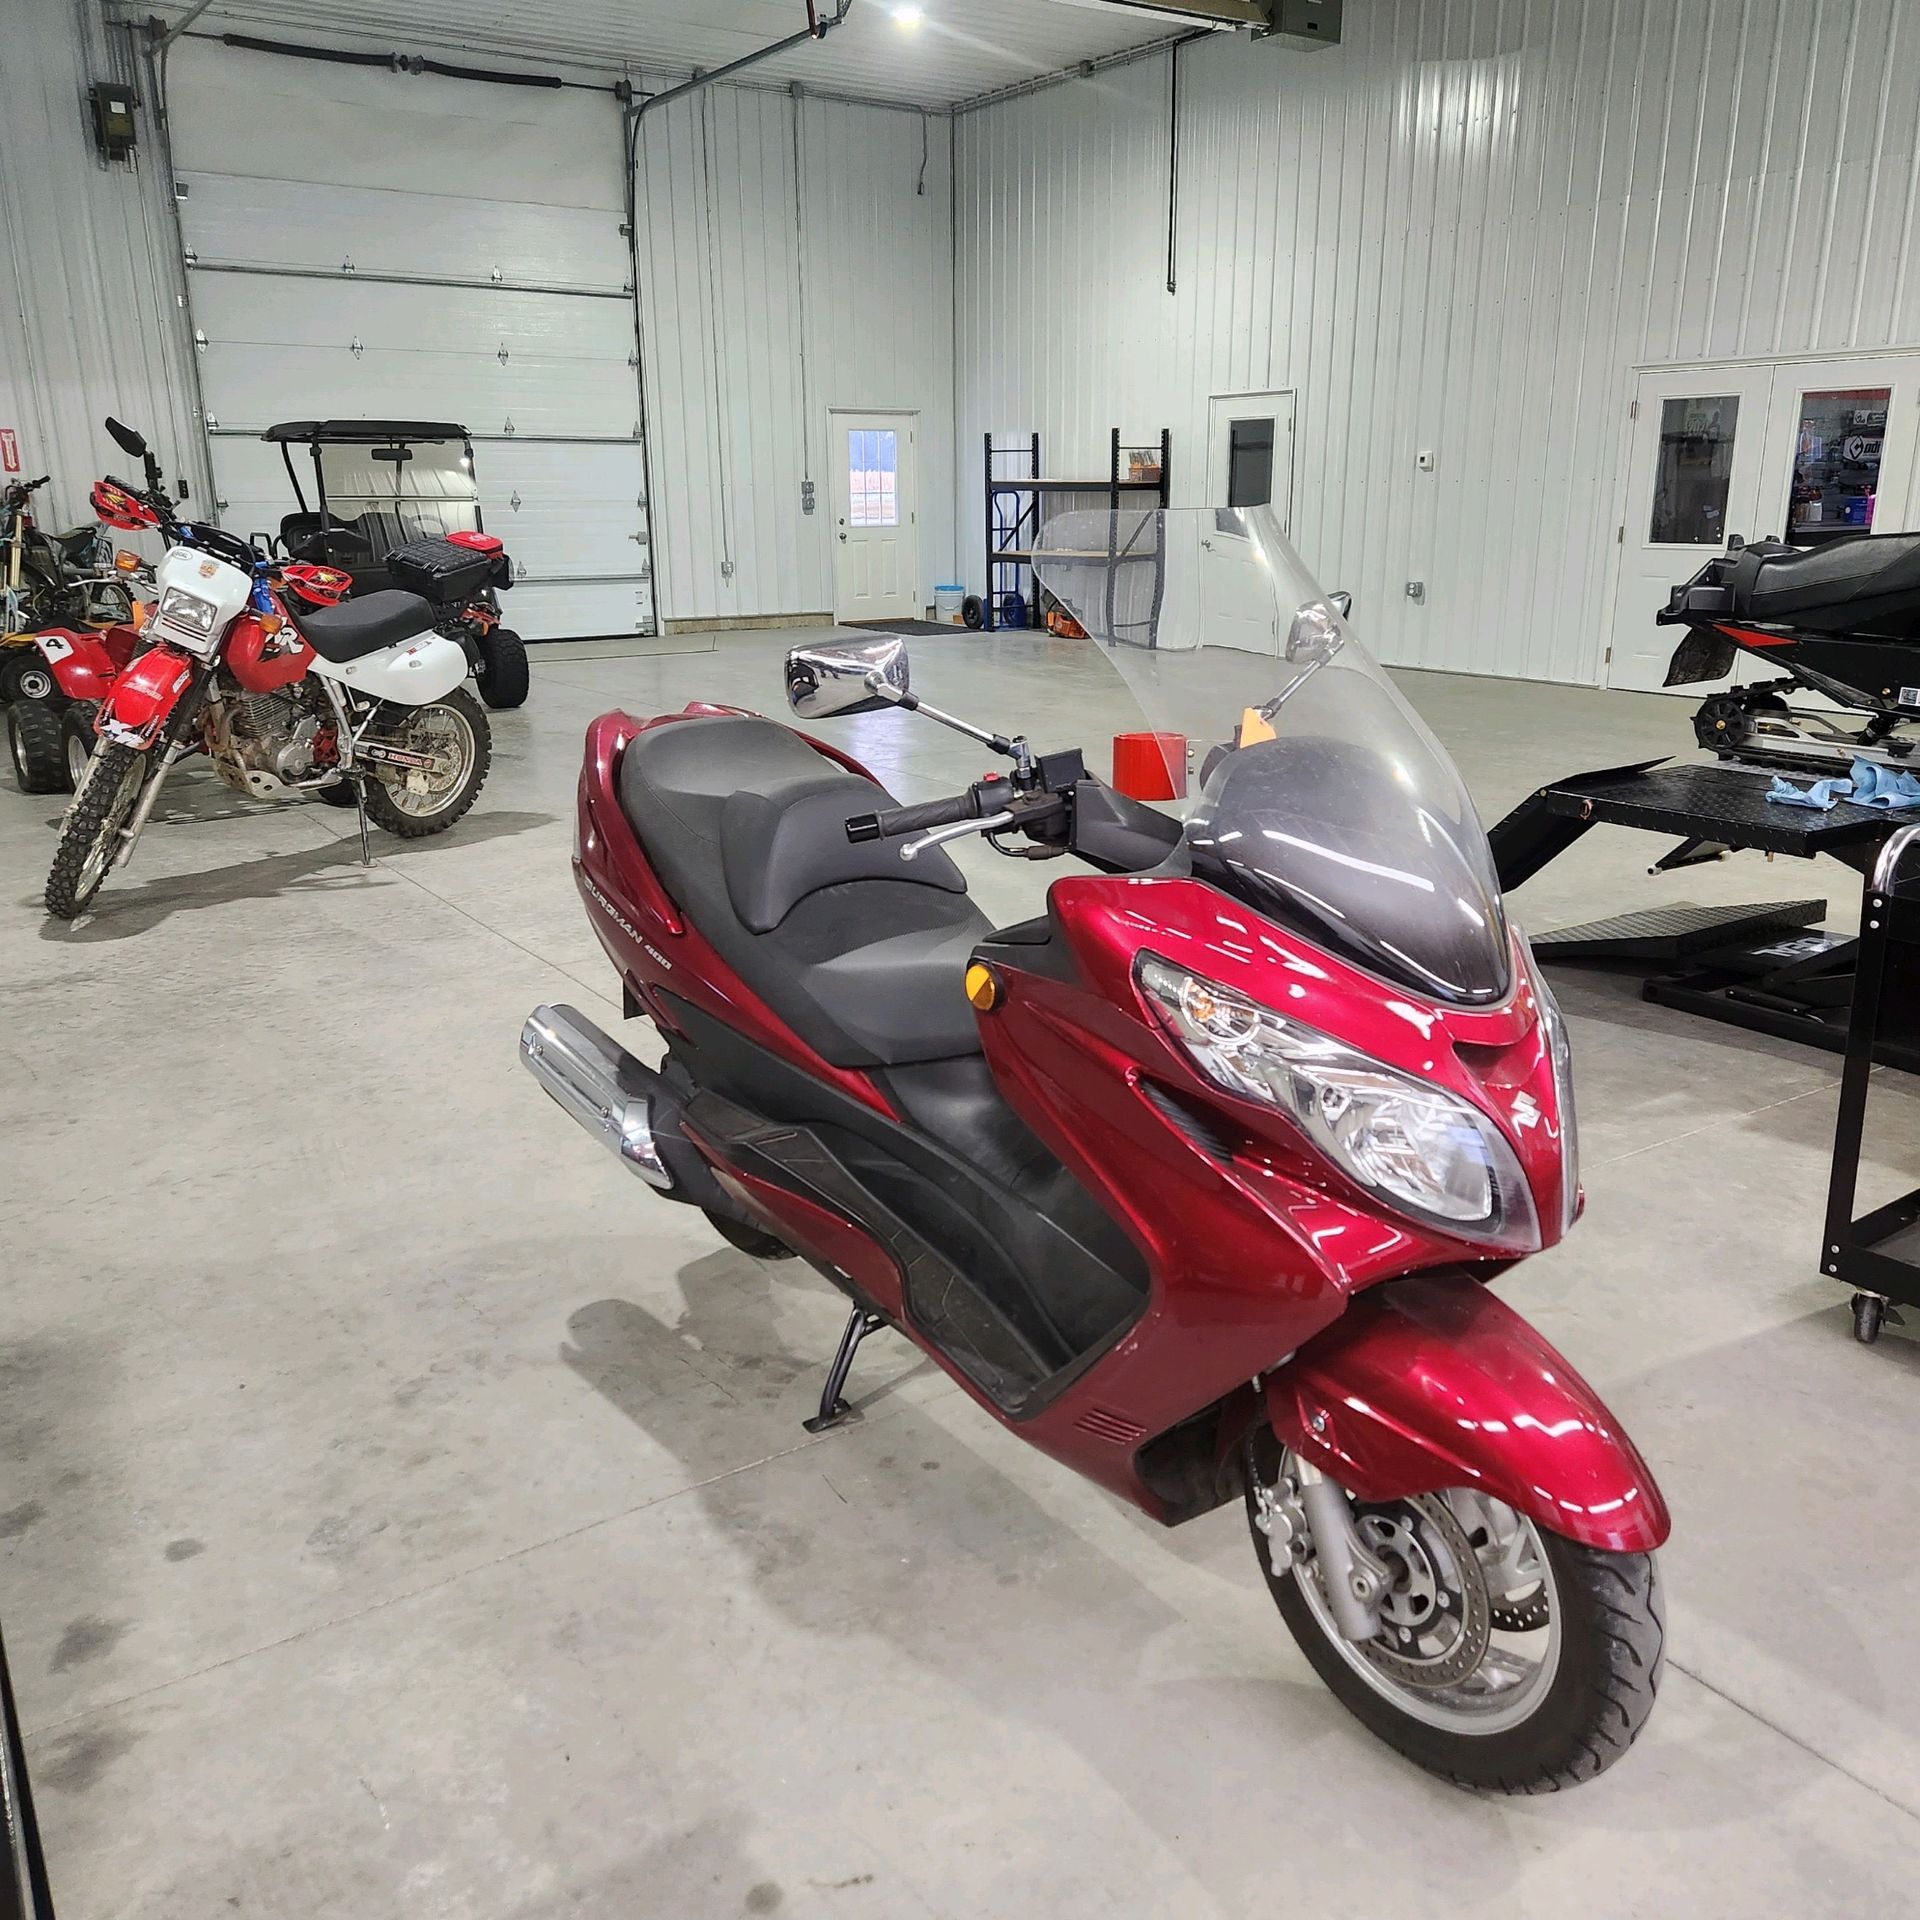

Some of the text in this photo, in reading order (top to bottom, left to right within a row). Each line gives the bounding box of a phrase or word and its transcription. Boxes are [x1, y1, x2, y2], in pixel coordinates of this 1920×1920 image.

[45, 638, 64, 649] 4
[387, 751, 423, 766] HONDA
[584, 874, 673, 970] BURGMAN 400
